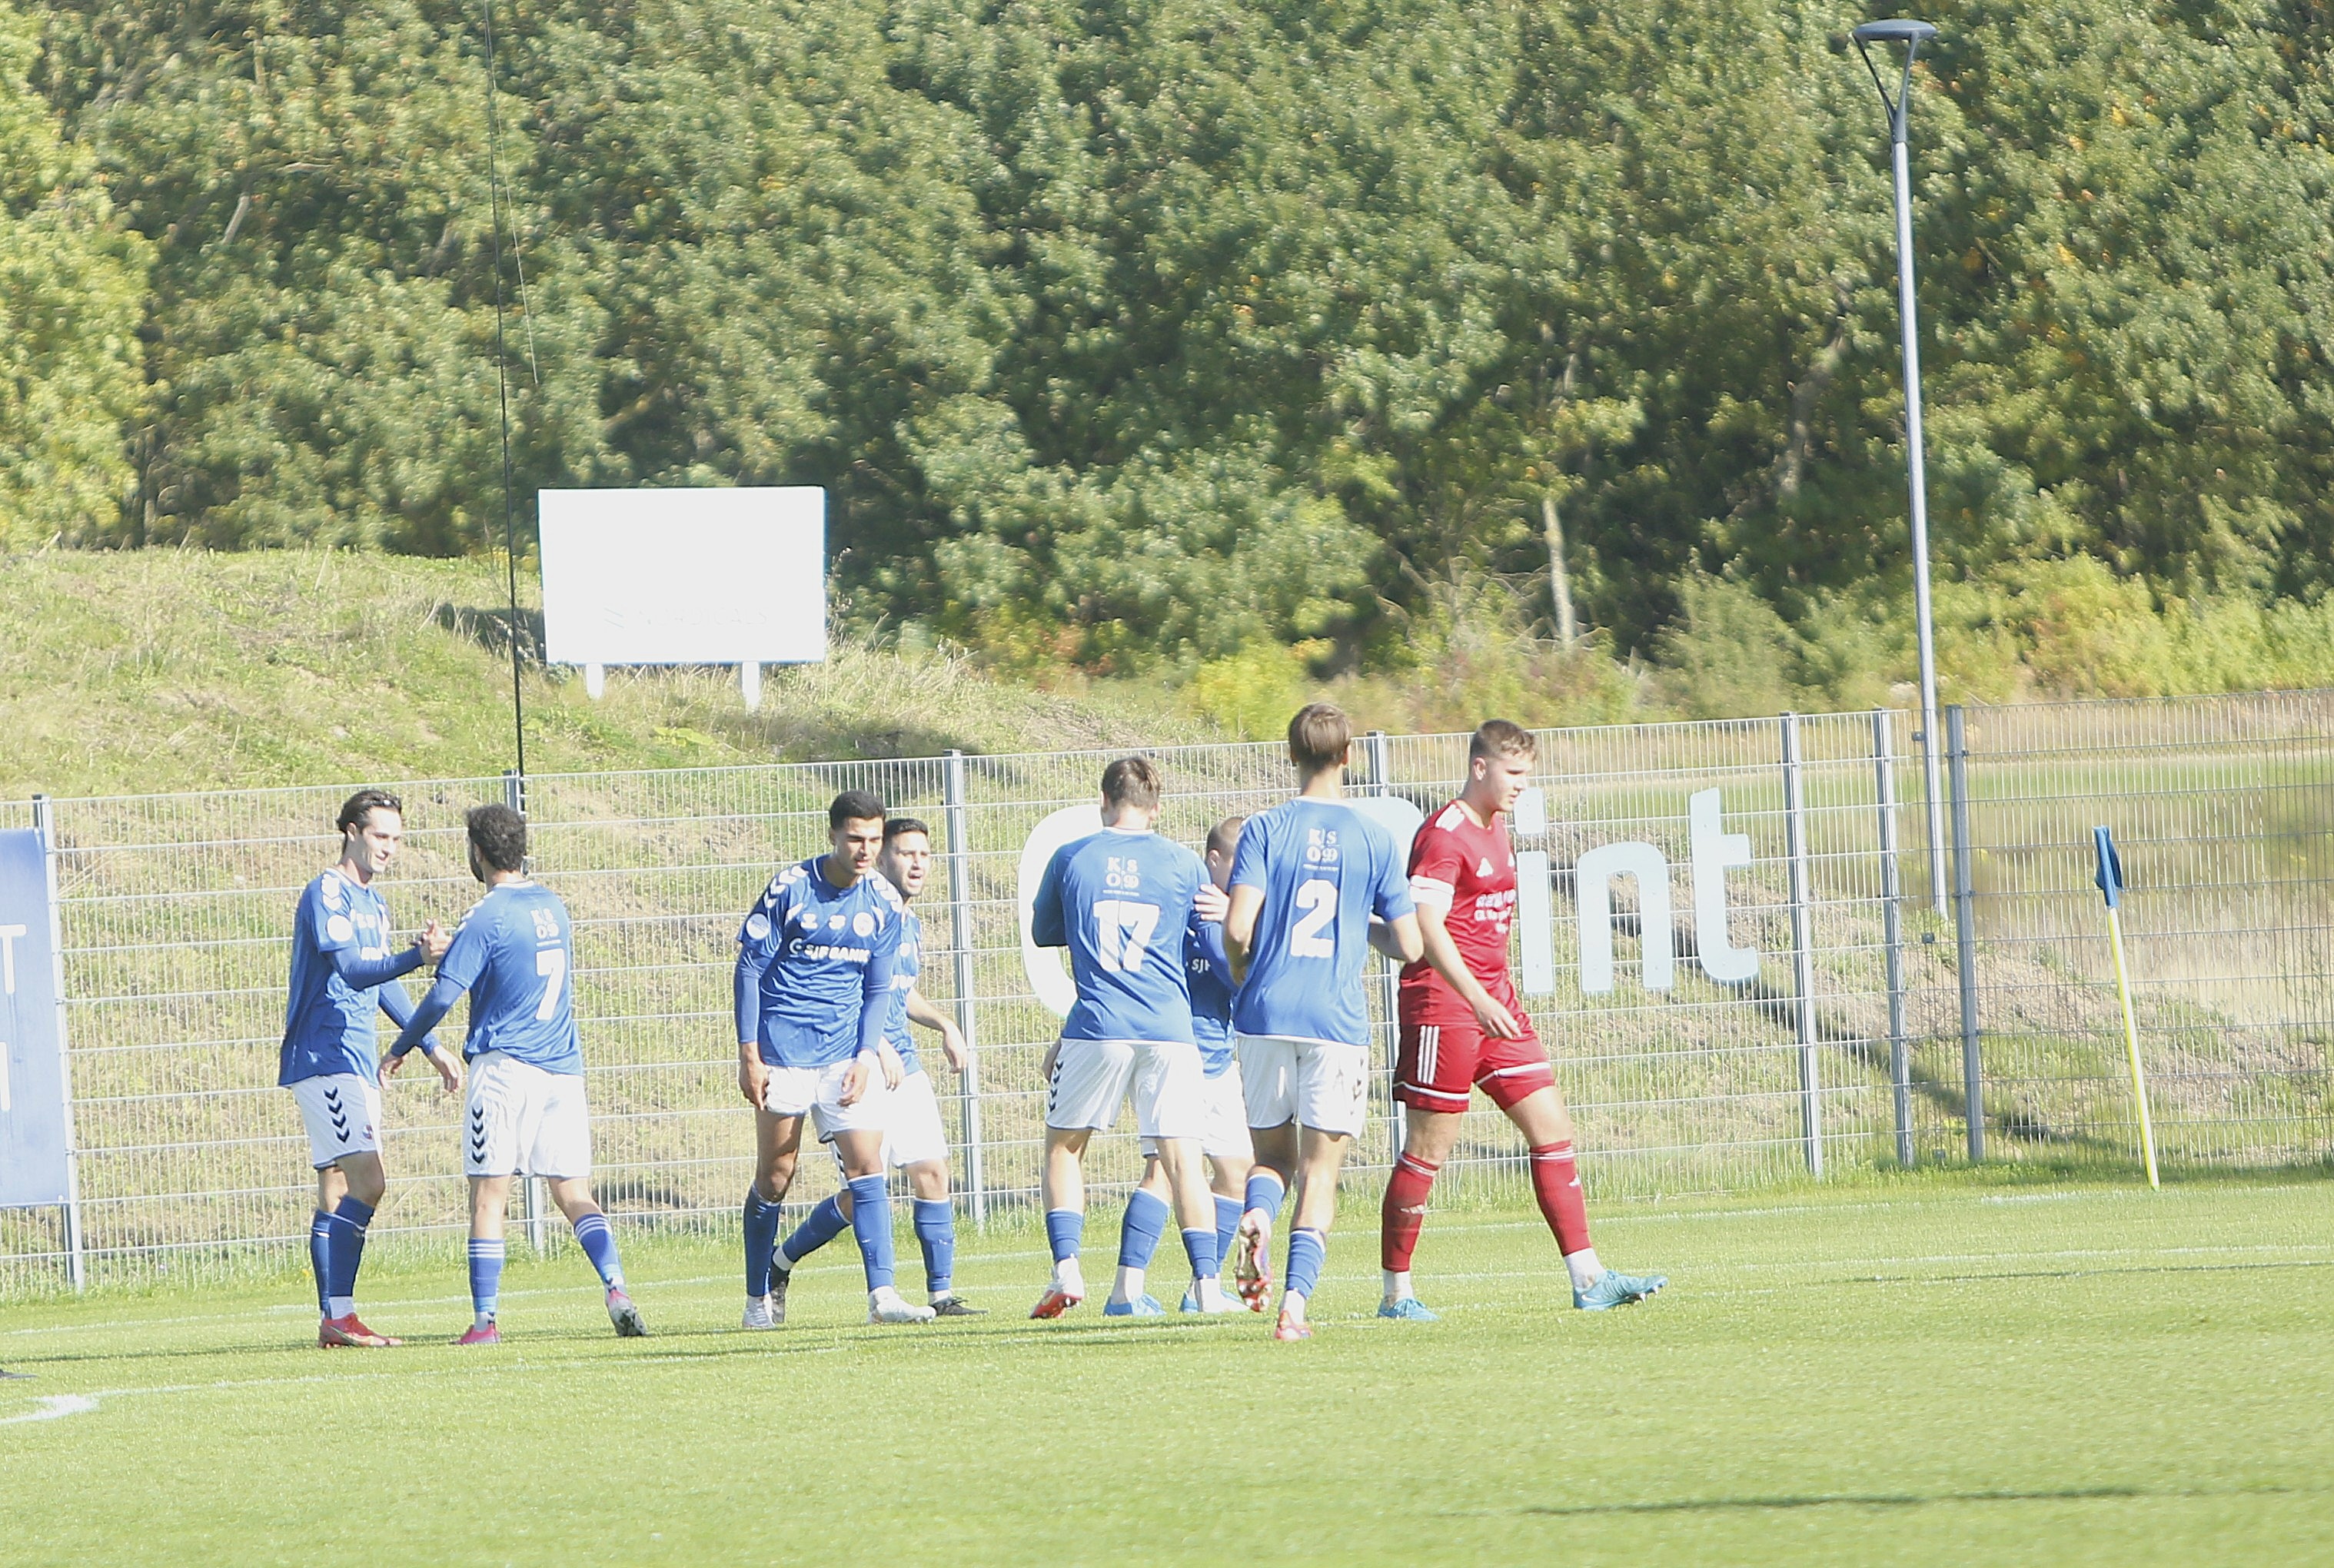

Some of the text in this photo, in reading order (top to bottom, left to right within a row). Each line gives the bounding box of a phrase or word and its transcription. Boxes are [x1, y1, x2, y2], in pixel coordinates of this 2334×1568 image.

[1093, 900, 1160, 972] 17
[1290, 879, 1338, 958] 2
[536, 948, 565, 1021] 7
